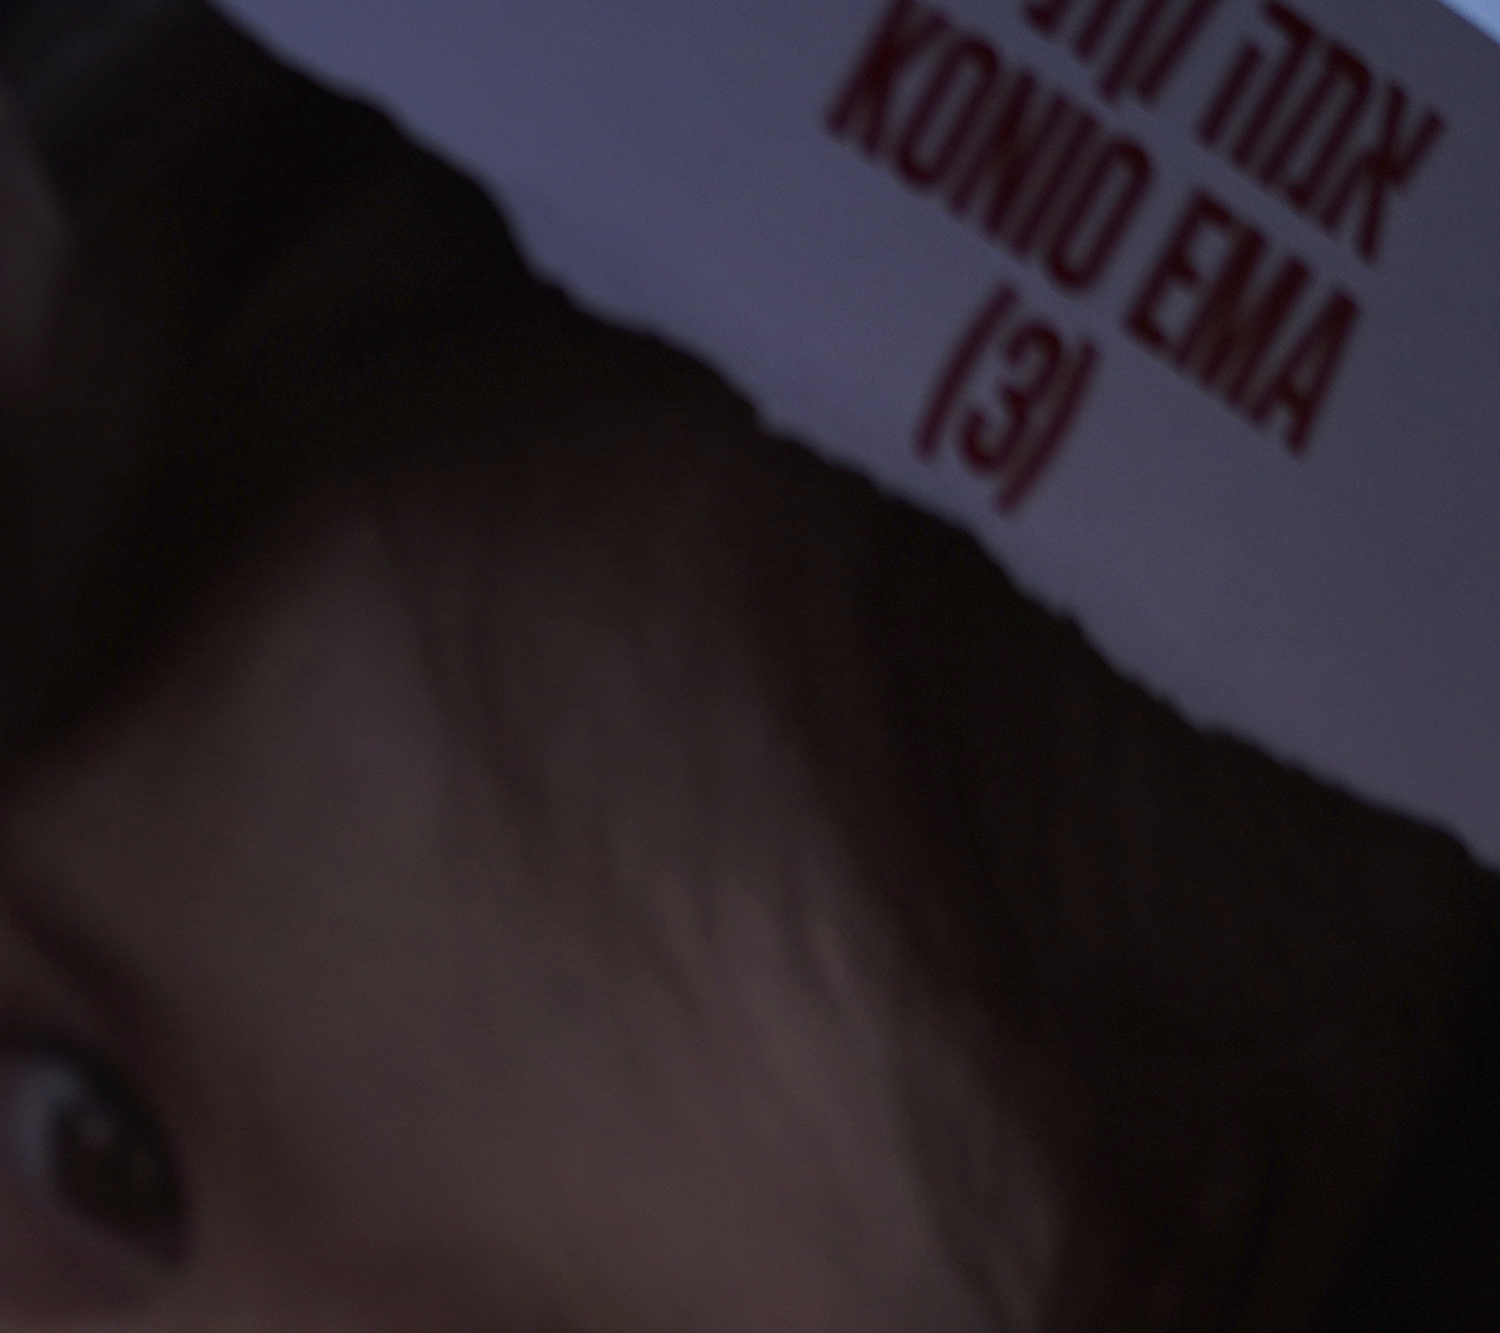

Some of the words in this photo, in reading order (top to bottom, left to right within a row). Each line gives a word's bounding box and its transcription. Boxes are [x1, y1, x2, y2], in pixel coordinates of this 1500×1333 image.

[822, 0, 1155, 294] KONIO
[1120, 188, 1362, 461] EMA
[913, 281, 1098, 518] (3)
